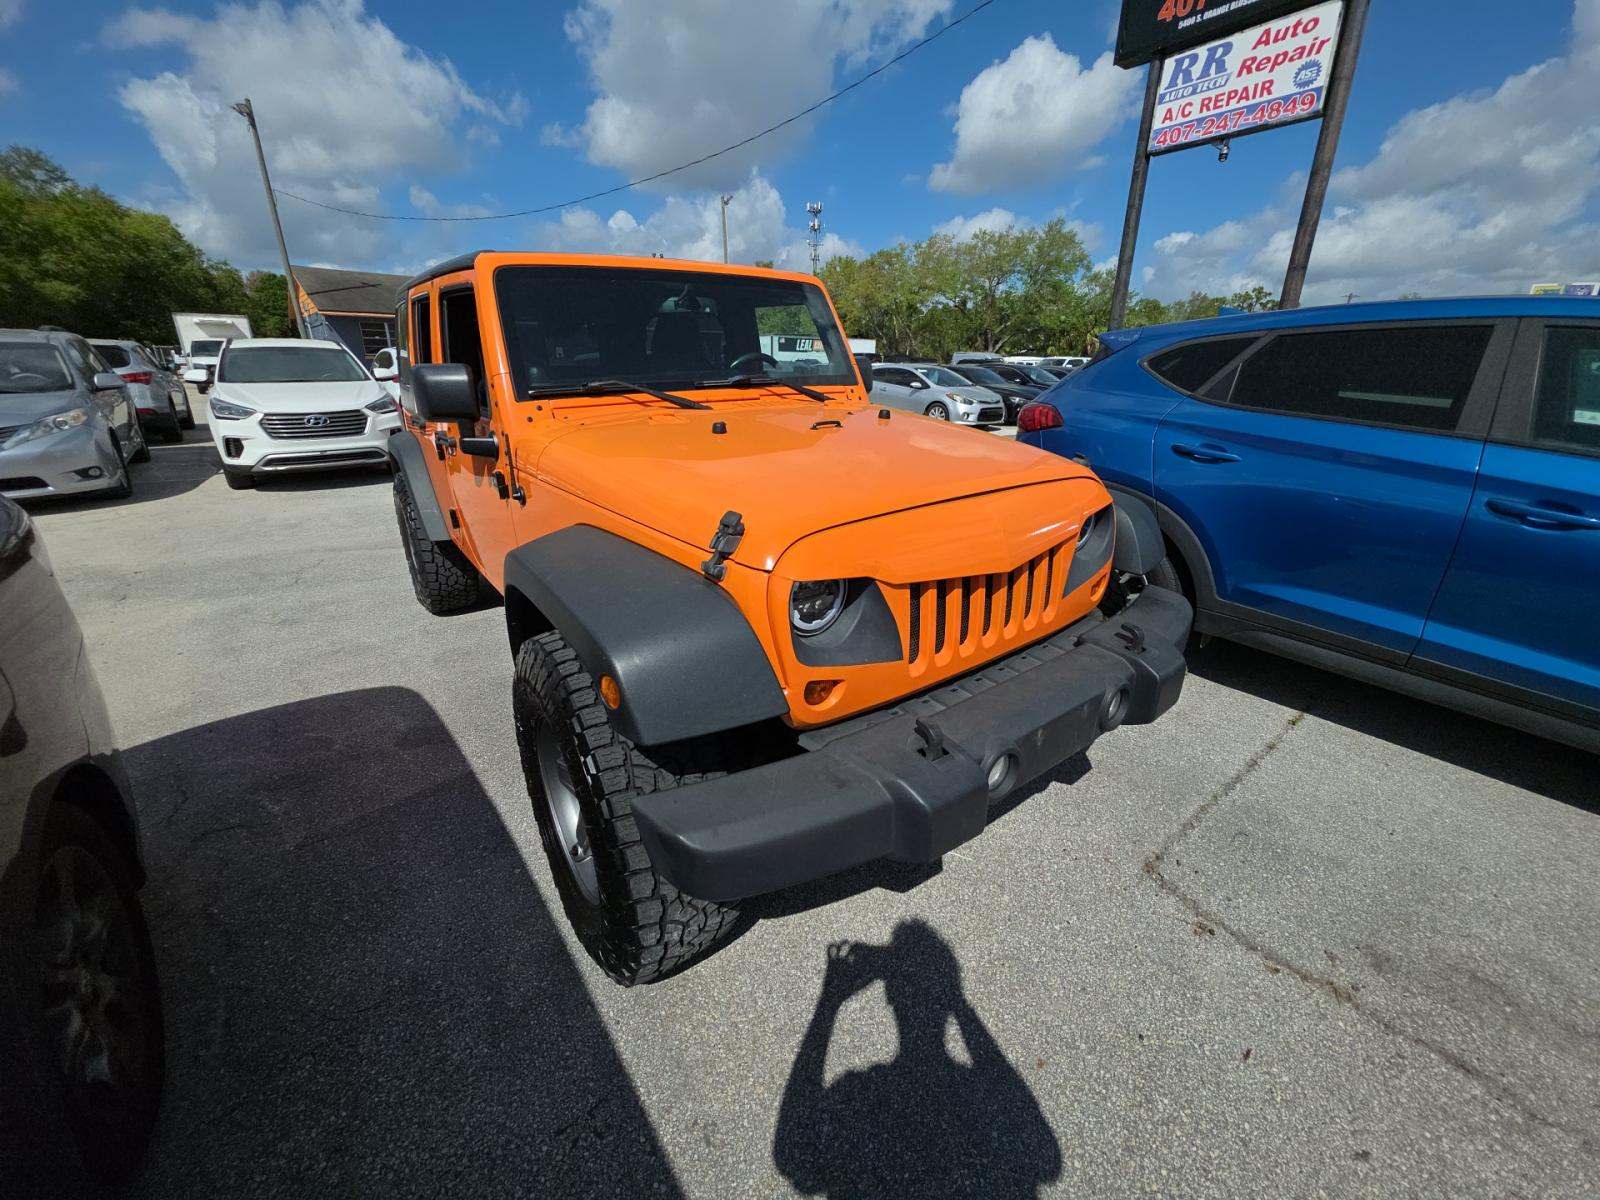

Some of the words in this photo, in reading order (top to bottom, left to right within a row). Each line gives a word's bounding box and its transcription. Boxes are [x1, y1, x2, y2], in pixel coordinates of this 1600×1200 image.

[1251, 16, 1320, 51] Auto
[1164, 41, 1234, 91] RR
[1236, 36, 1331, 78] Repair
[1297, 67, 1318, 81] ASE
[1161, 101, 1194, 124] A/C
[1199, 79, 1274, 114] REPAIR
[1162, 86, 1193, 103] AUTO
[1197, 76, 1227, 93] TECH
[1154, 91, 1317, 147] 407-247-4849
[795, 339, 813, 351] LEAL
